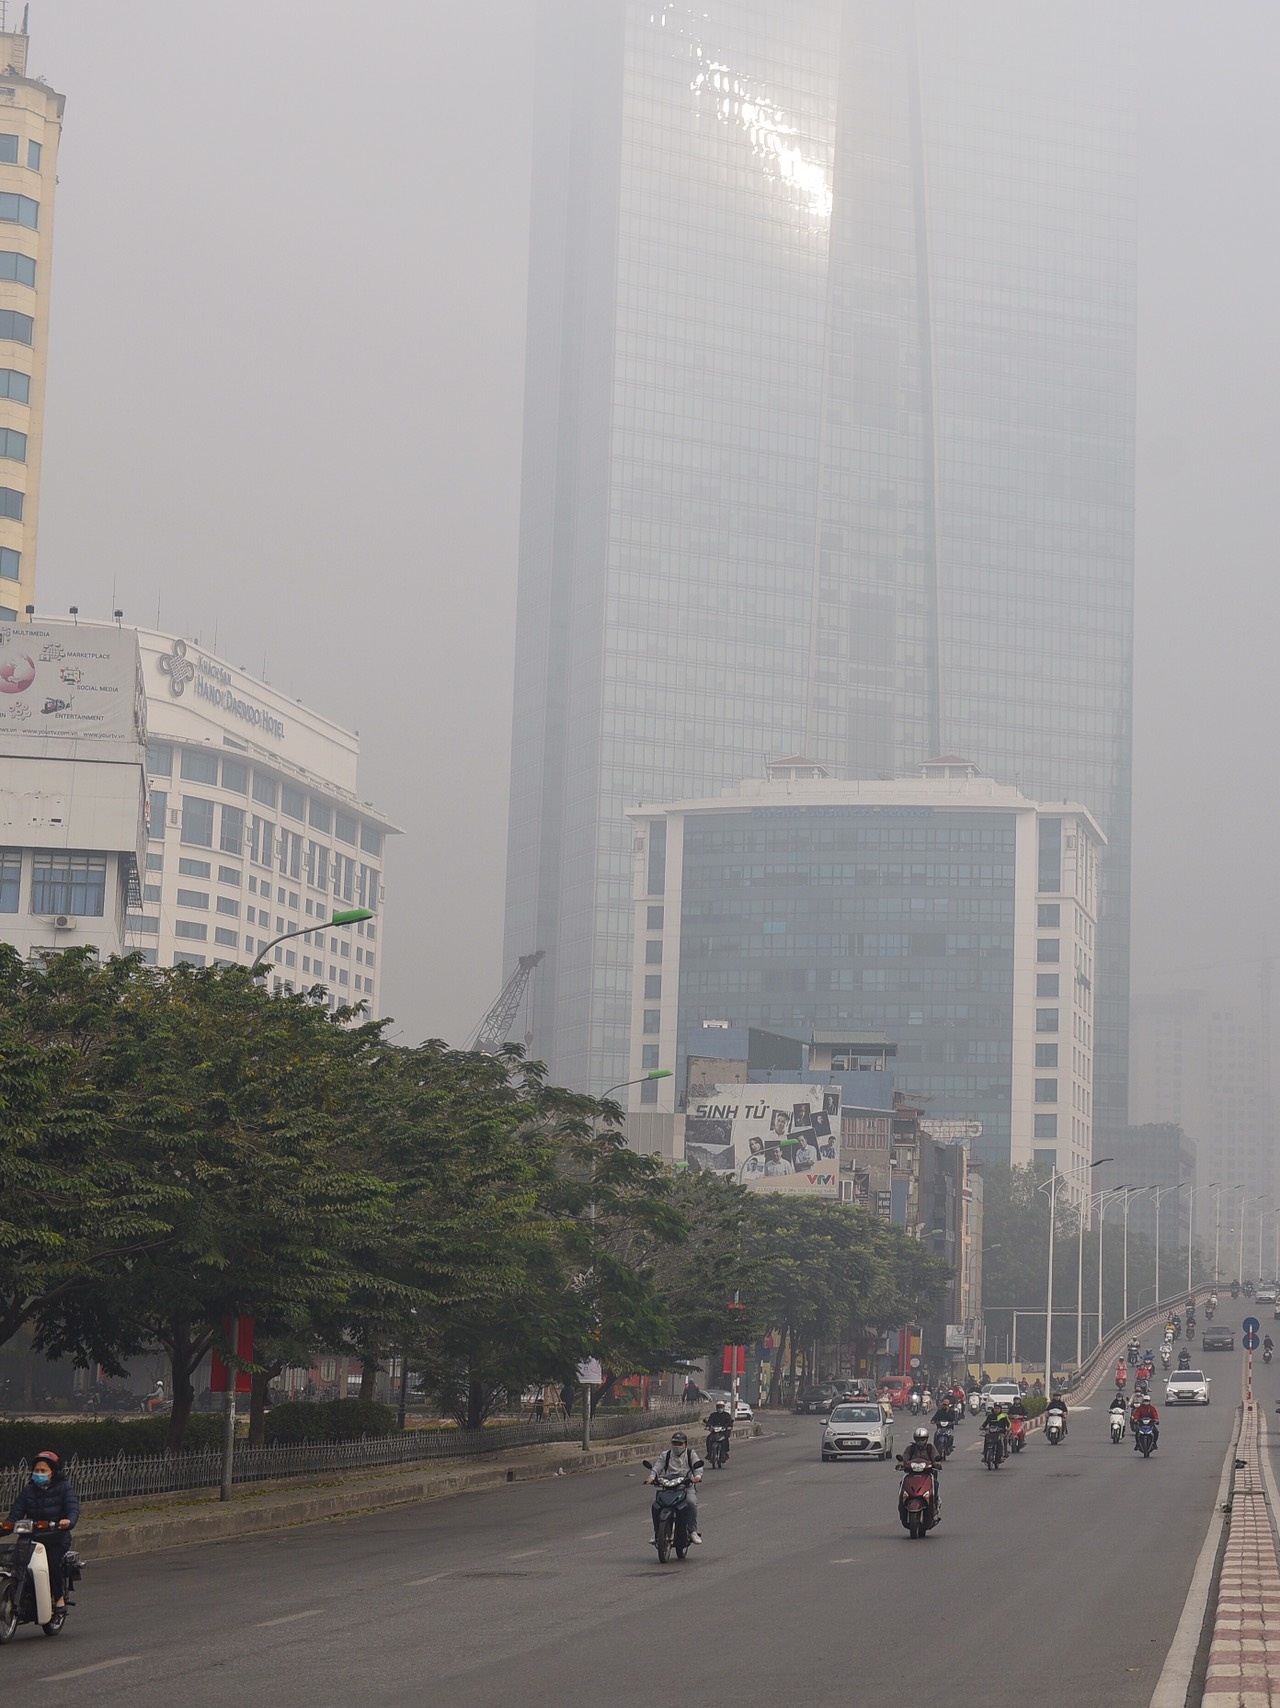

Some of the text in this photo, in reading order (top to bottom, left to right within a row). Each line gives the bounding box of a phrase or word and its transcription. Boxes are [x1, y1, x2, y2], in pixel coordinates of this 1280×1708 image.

[12, 629, 50, 638] MULTIMEDIA
[66, 651, 111, 660] MARKETPLACE
[76, 684, 119, 693] SOCIAL MEDIA
[54, 713, 105, 721] ENTERTAINMENT
[694, 1104, 738, 1119] SINH
